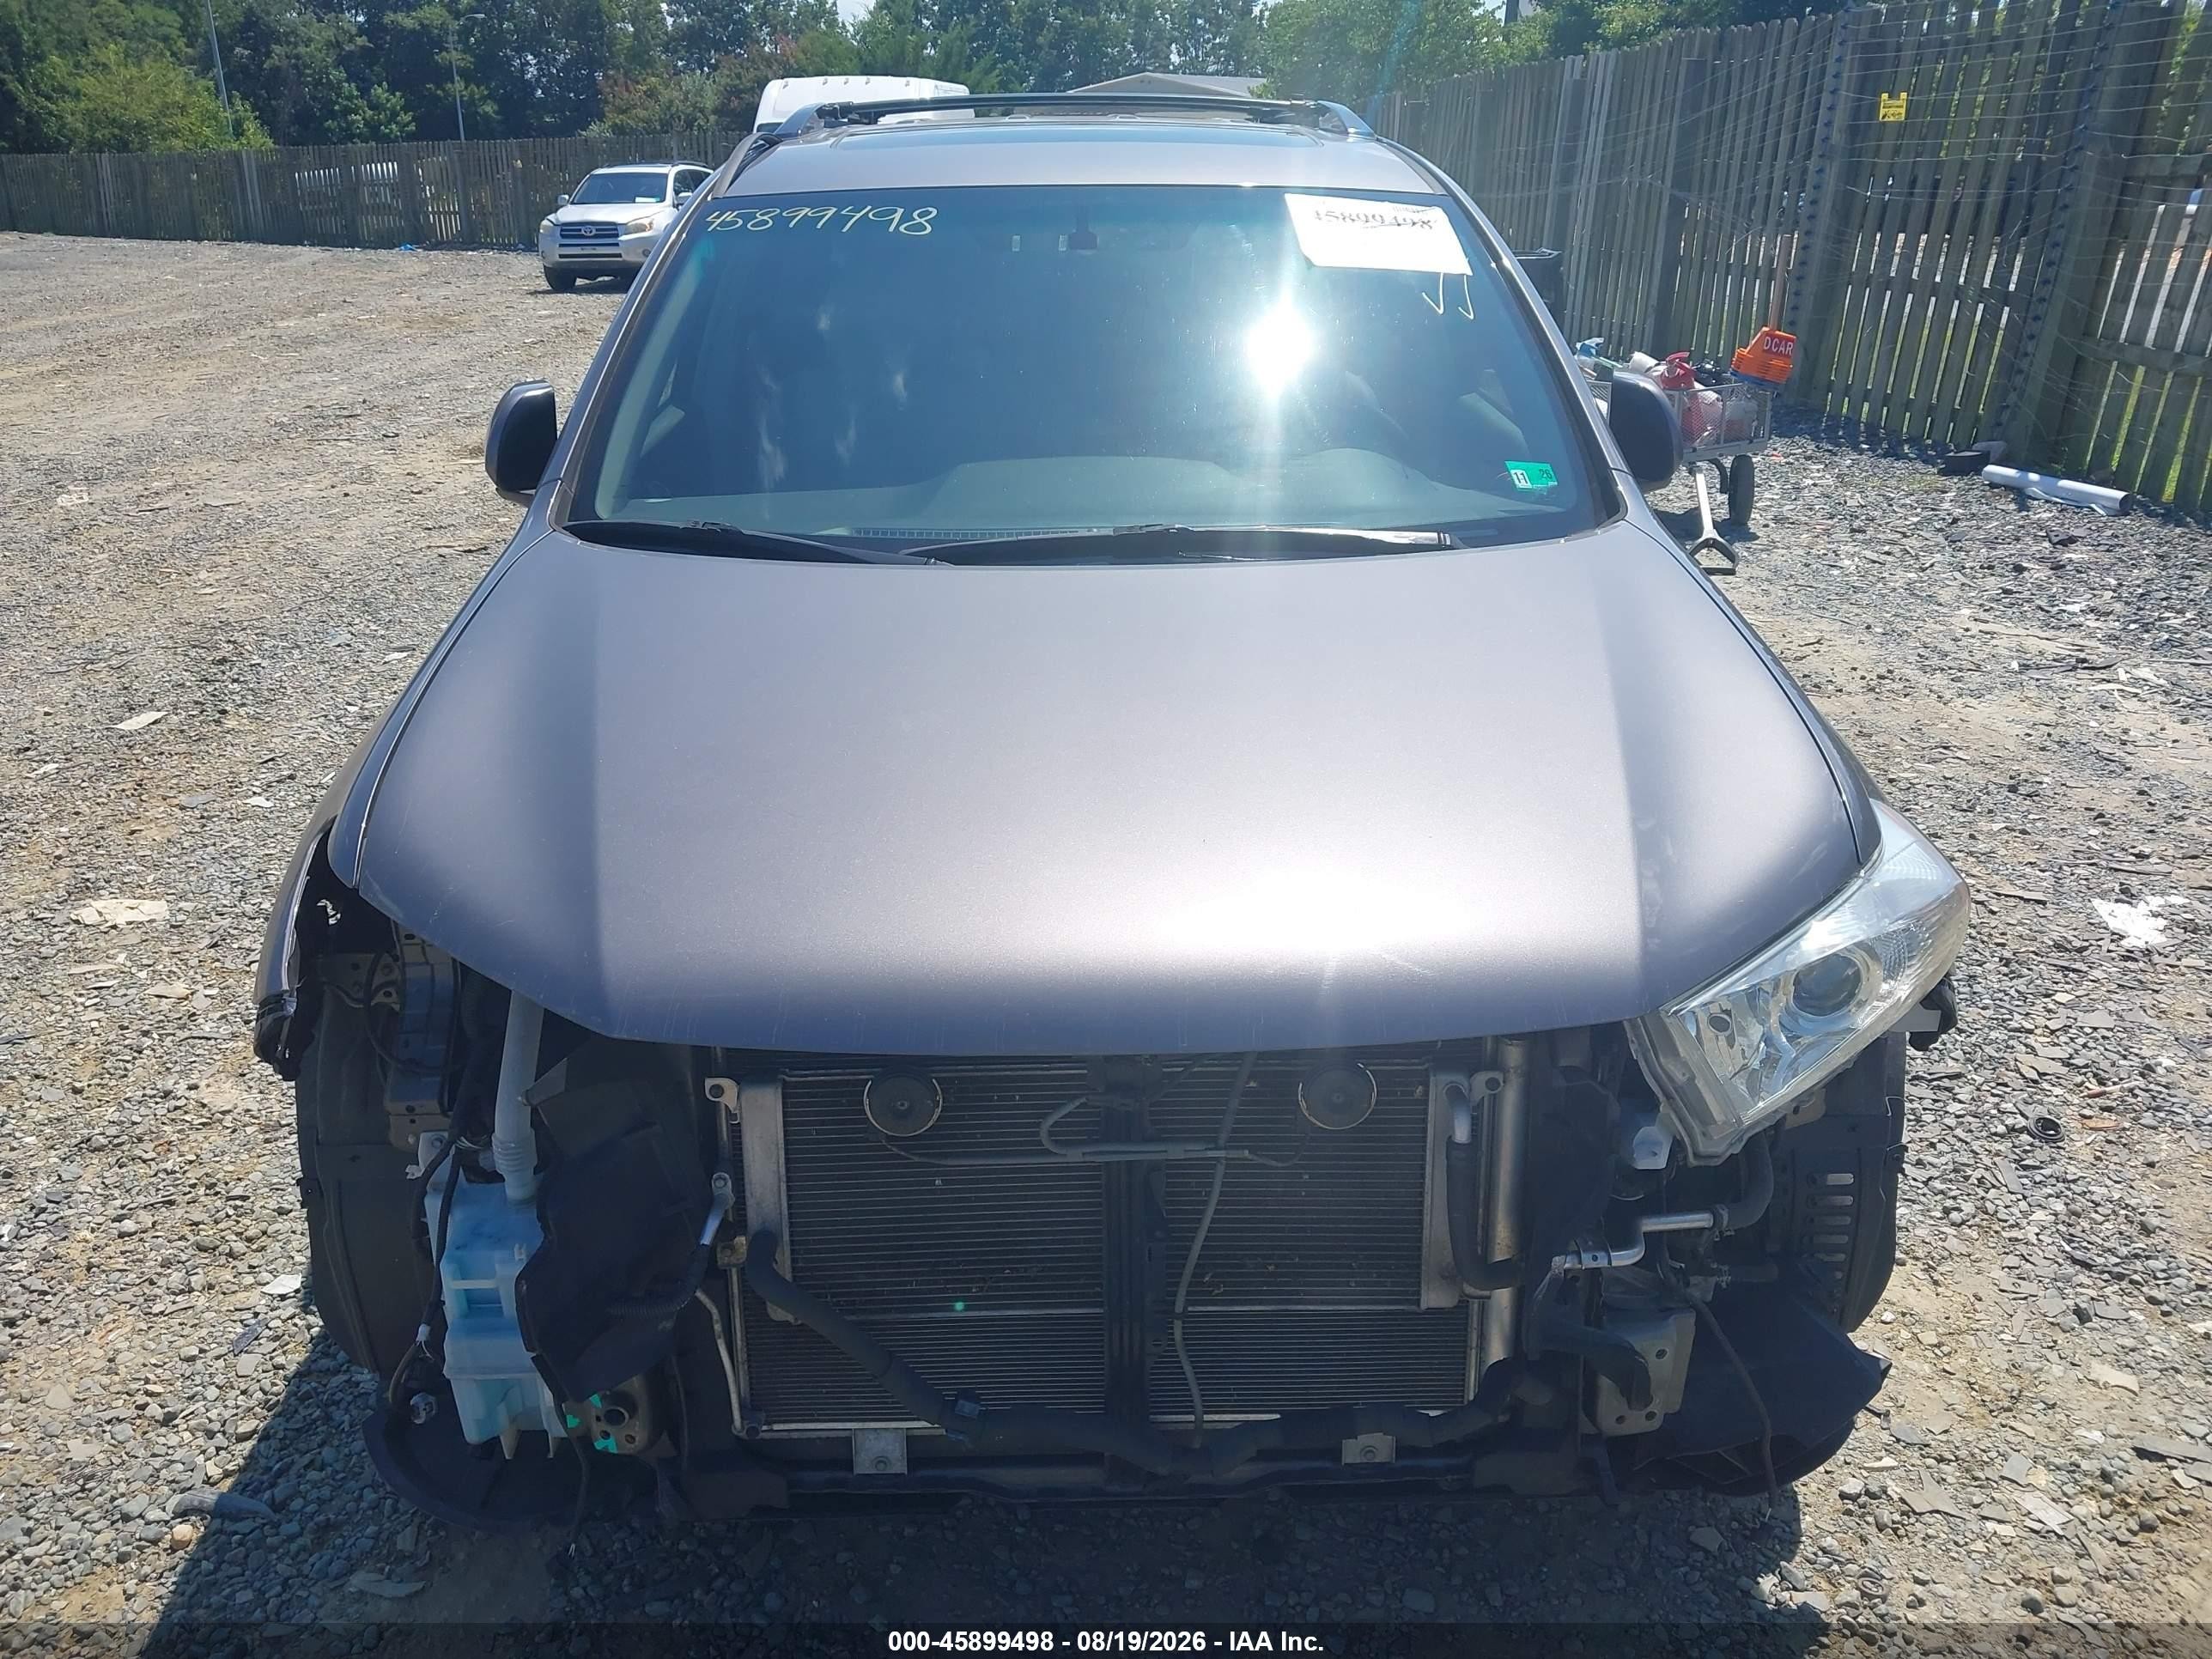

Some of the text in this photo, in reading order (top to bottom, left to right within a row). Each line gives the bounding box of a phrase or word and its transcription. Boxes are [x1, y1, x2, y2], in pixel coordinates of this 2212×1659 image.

[705, 205, 939, 236] 45899498
[1764, 337, 1793, 356] DCAR
[1514, 472, 1528, 484] 11
